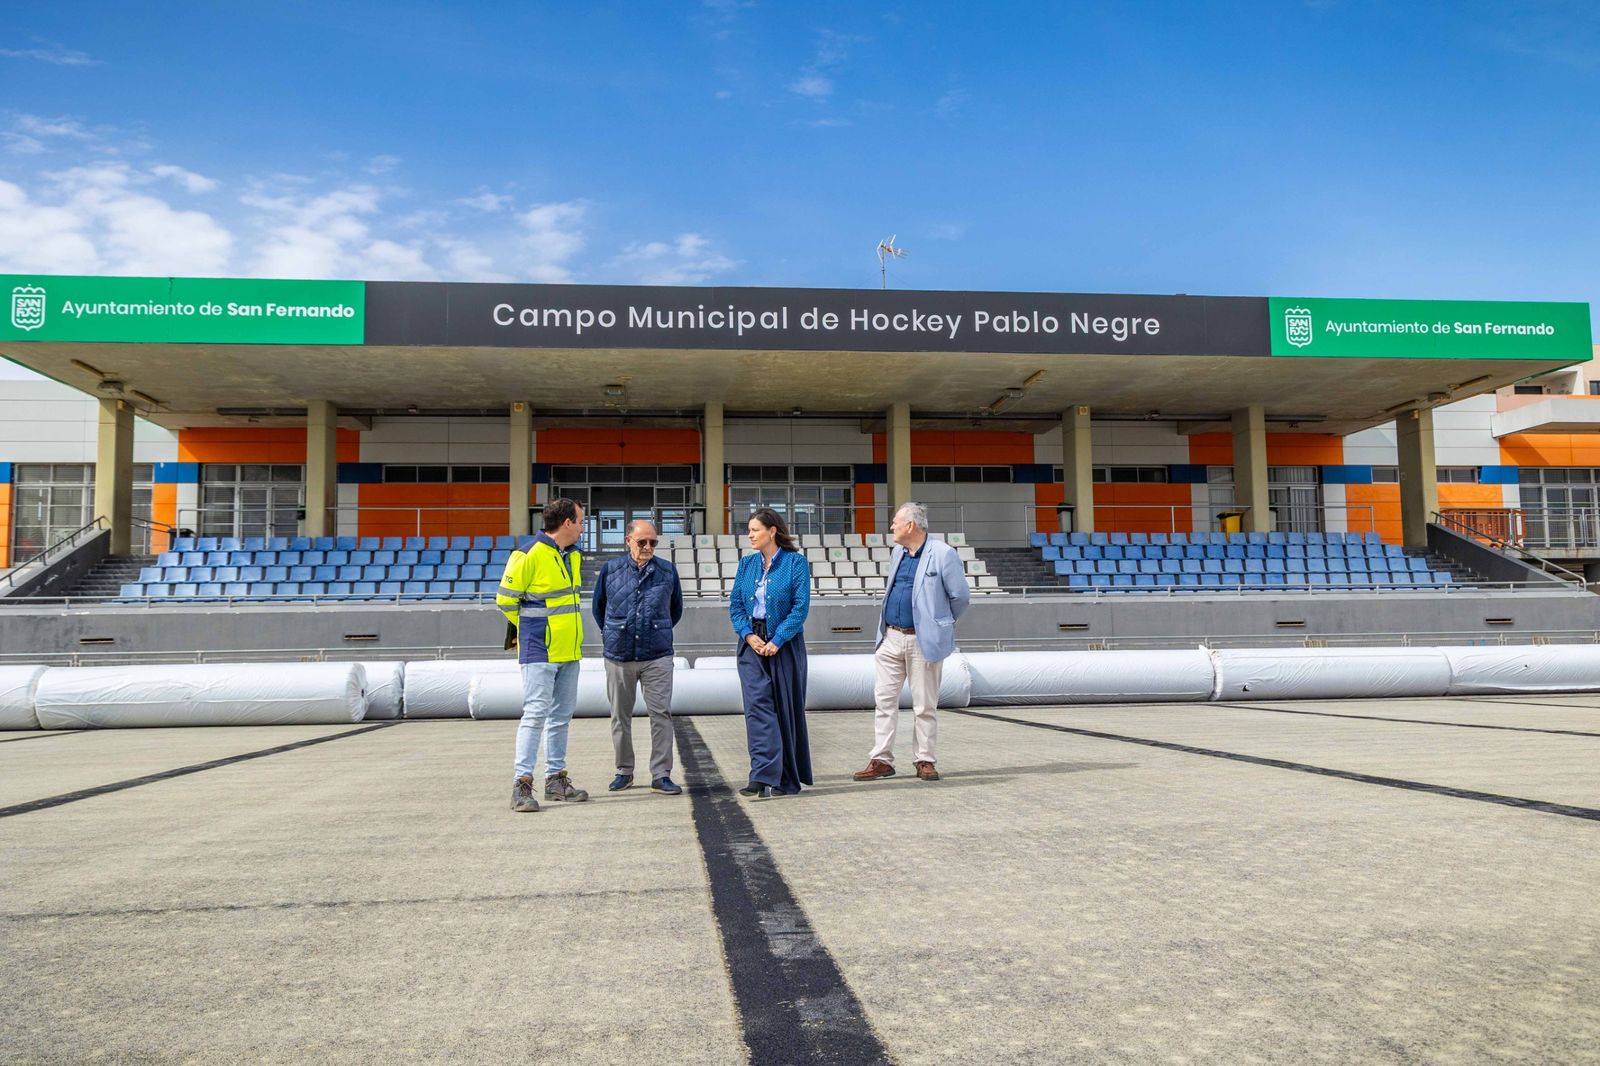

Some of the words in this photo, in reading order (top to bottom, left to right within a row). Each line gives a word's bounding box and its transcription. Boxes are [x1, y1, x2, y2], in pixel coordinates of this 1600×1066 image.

[16, 298, 41, 308] SAN
[61, 300, 195, 319] Ayuntamiento
[198, 302, 223, 316] de
[227, 302, 263, 317] San
[266, 303, 355, 318] Fernando
[492, 303, 617, 335] Campo
[628, 304, 788, 336] Municipal
[800, 306, 839, 331] de
[850, 308, 962, 340] Hockey
[974, 310, 1059, 334] Pablo
[1070, 312, 1161, 342] Negre
[1290, 319, 1308, 327] SAN
[1325, 320, 1429, 337] Ayuntamiento
[1431, 321, 1451, 334] de
[1453, 321, 1483, 334] San
[1484, 322, 1555, 336] Fernando
